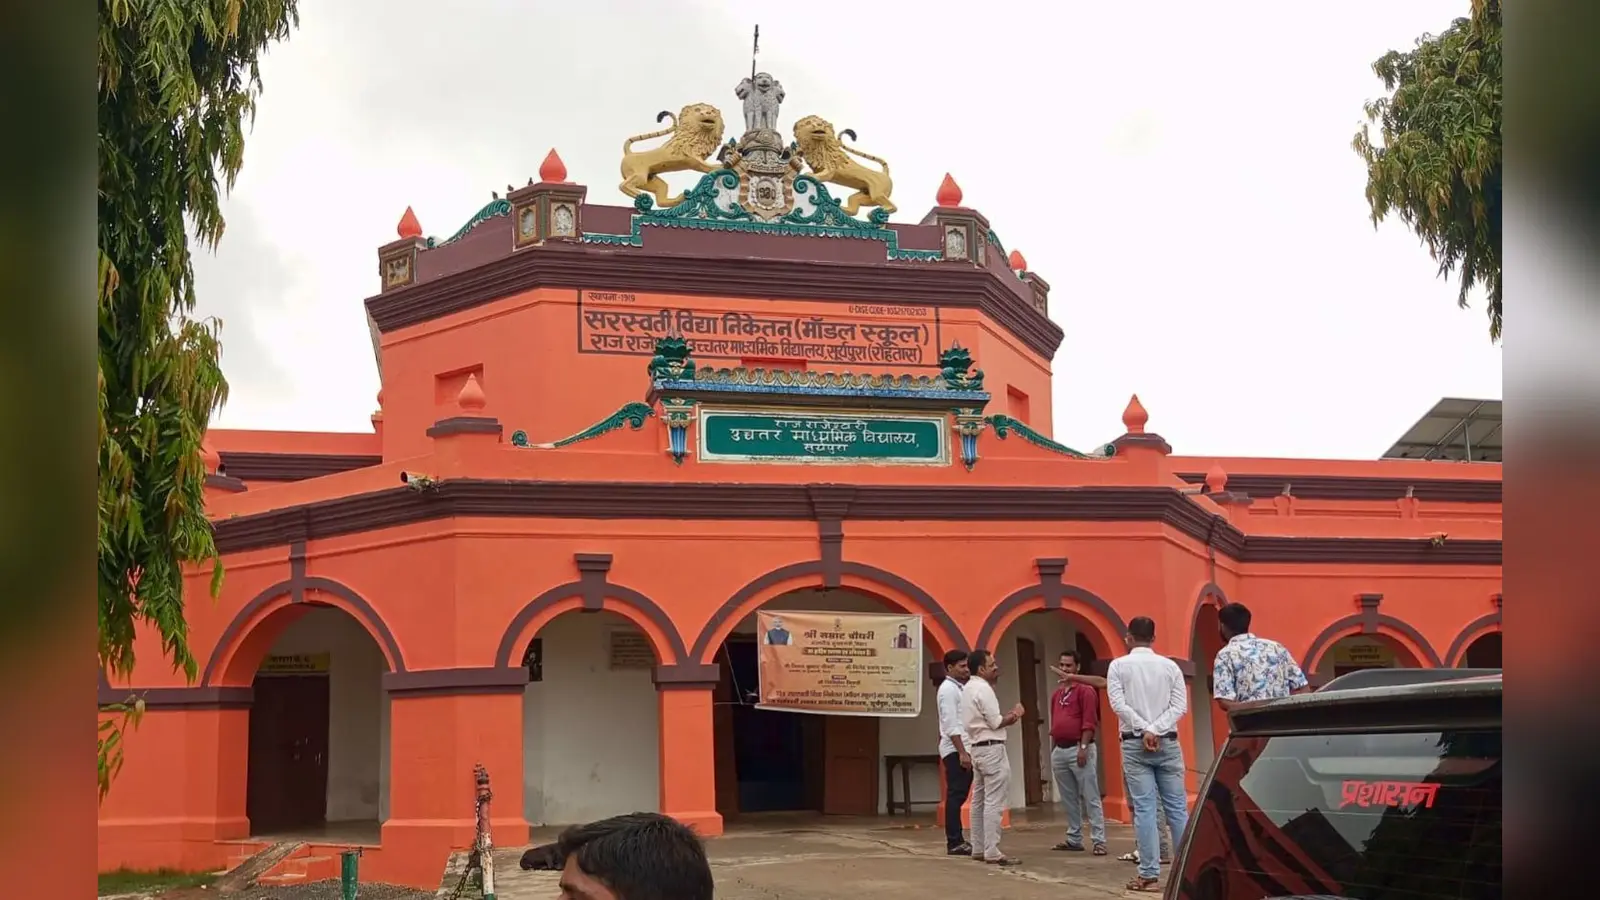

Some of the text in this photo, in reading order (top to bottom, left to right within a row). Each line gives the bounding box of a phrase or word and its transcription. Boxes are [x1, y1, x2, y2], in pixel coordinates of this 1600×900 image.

[584, 309, 672, 332] सरस्वती
[675, 310, 719, 335] विद्या
[721, 312, 793, 338] निकेतन
[860, 323, 930, 346] स्कूल)
[590, 333, 624, 350] राज
[730, 336, 779, 357] माध्यमिक
[867, 342, 923, 364] (रोहतास)
[790, 428, 857, 443] माध्यमिक
[804, 629, 818, 639] श्री
[1338, 780, 1441, 808] प्रशासन
